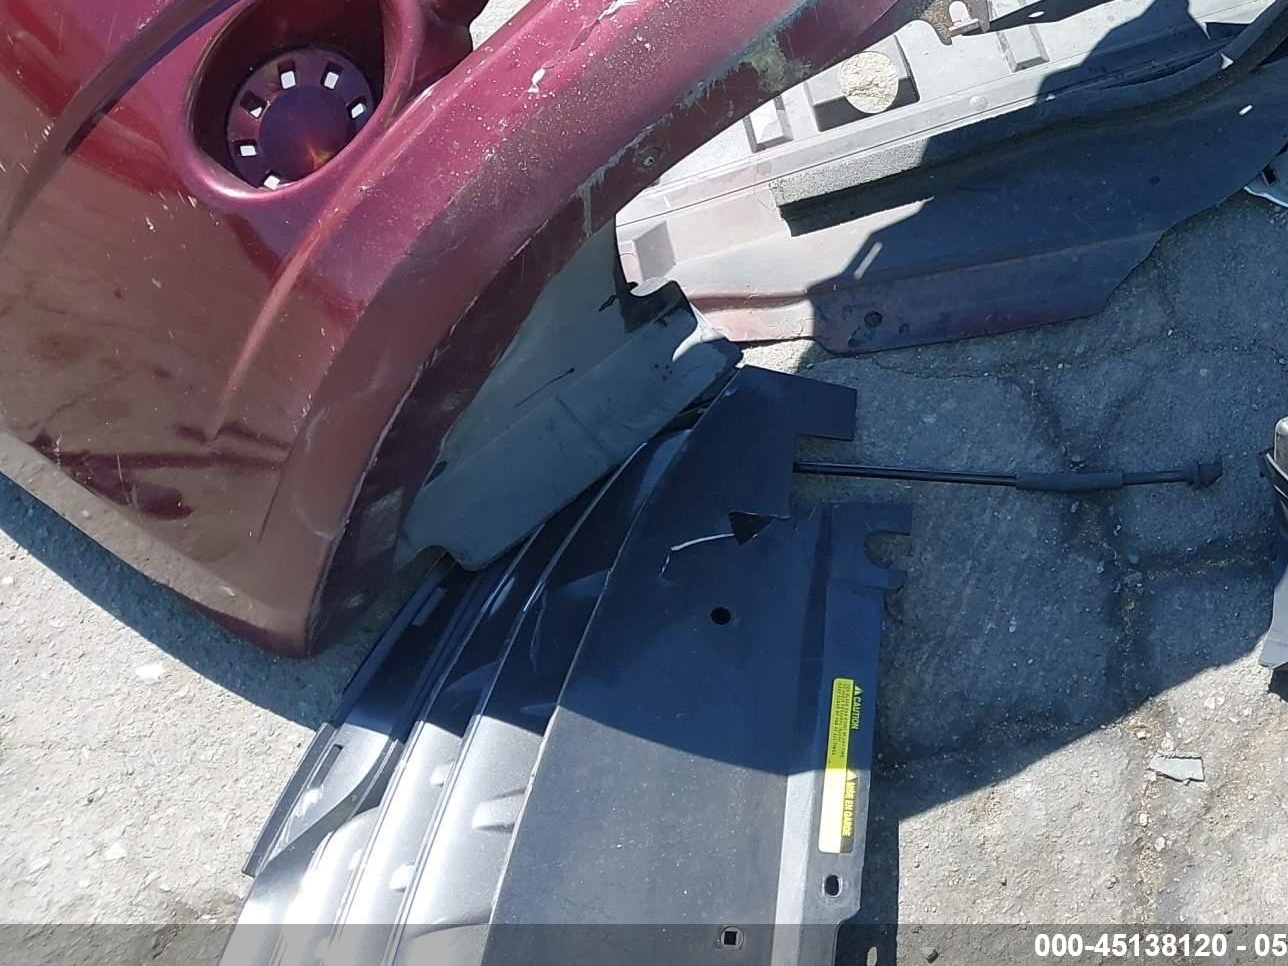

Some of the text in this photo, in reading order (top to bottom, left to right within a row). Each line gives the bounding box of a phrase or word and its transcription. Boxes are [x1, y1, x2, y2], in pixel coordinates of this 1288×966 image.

[851, 696, 861, 730] CAUTION
[844, 800, 854, 811] EN
[842, 811, 853, 837] GARDE
